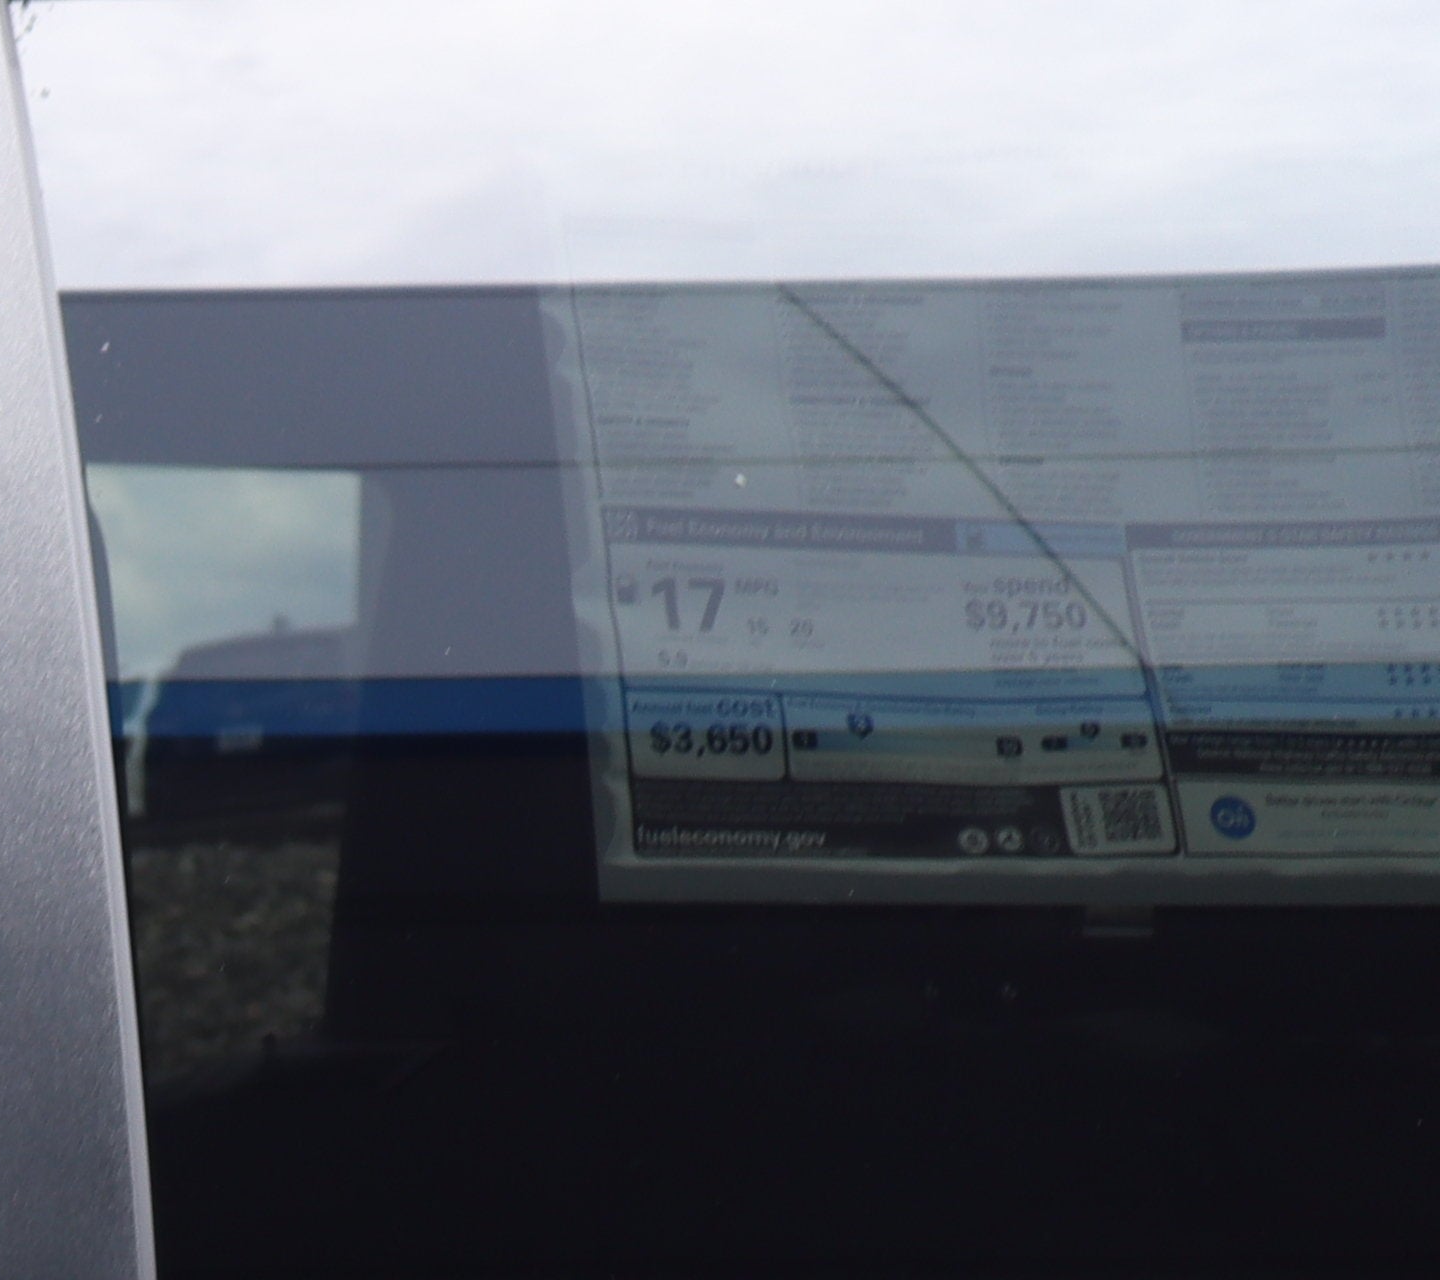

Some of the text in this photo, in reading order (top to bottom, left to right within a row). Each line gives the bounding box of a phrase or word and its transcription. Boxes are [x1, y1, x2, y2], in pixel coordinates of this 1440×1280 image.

[645, 515, 683, 538] Fuel
[687, 518, 770, 542] Economy
[735, 576, 780, 598] MPG
[992, 574, 1070, 600] spend
[650, 576, 726, 633] 17
[963, 598, 1087, 636] $9,750
[716, 698, 775, 720] cost
[649, 719, 773, 761] $3,650
[636, 822, 828, 852] fueleconomy.gov
